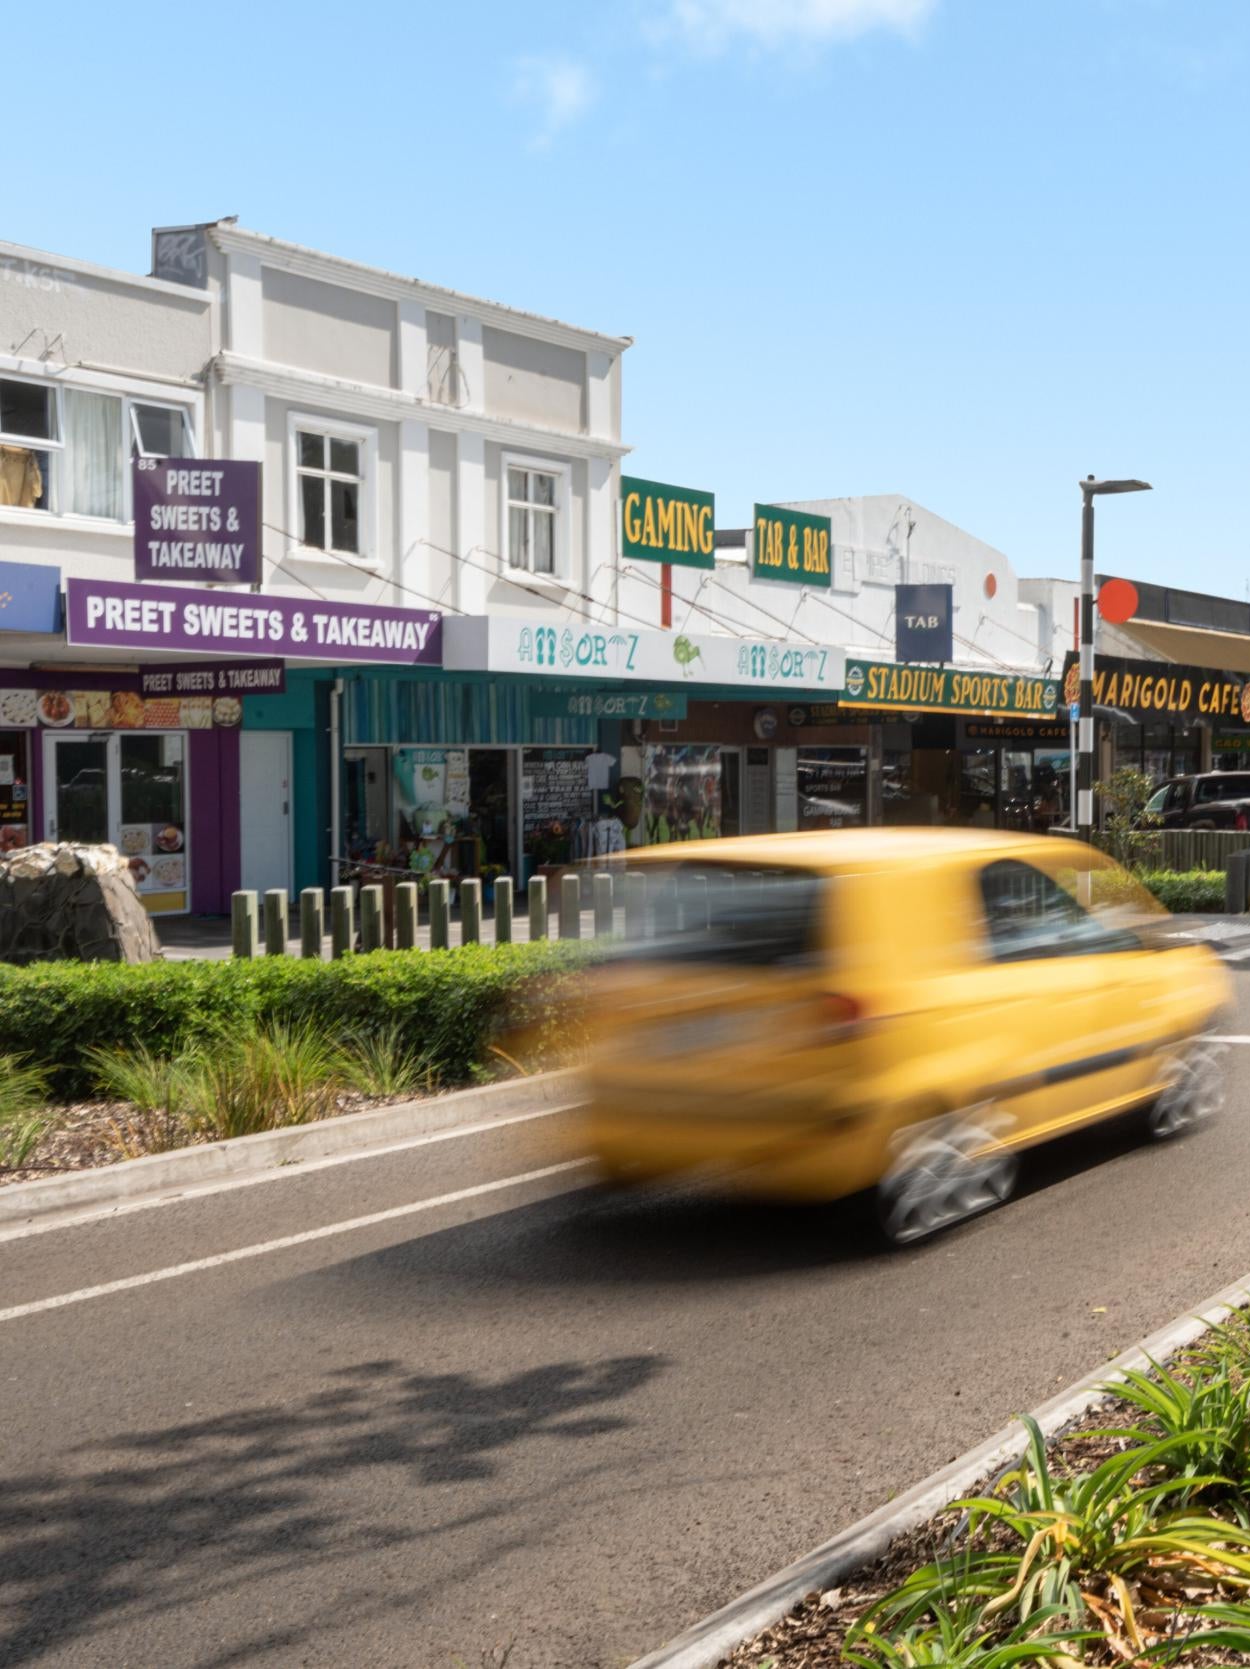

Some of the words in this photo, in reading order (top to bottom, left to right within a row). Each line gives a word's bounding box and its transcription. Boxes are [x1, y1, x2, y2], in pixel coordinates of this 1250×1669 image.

[137, 459, 157, 471] 85
[166, 469, 224, 496] PREET
[150, 504, 222, 532] SWEETS
[226, 506, 240, 532] &
[624, 492, 714, 554] GAMING
[147, 541, 244, 570] TAKEAWAY
[757, 518, 783, 568] TAB
[787, 524, 799, 570] &
[803, 526, 829, 574] BAR
[86, 596, 176, 634] PREET
[183, 603, 283, 641] SWEETS
[290, 612, 308, 643] &
[313, 614, 430, 650] TAKEAWAY
[904, 616, 939, 629] TAB
[143, 673, 173, 692] PREET
[176, 671, 215, 691] SWEETS
[218, 671, 227, 689] &
[228, 668, 281, 689] TAKEAWAY
[867, 666, 946, 703] STADIUM
[951, 674, 1009, 707] SPORTS
[1014, 679, 1043, 709] BAR
[1092, 670, 1193, 712] MARIGOLD
[1198, 681, 1240, 714] CAFE
[980, 727, 1035, 737] MARIGOLD
[1040, 727, 1067, 737] CAFE
